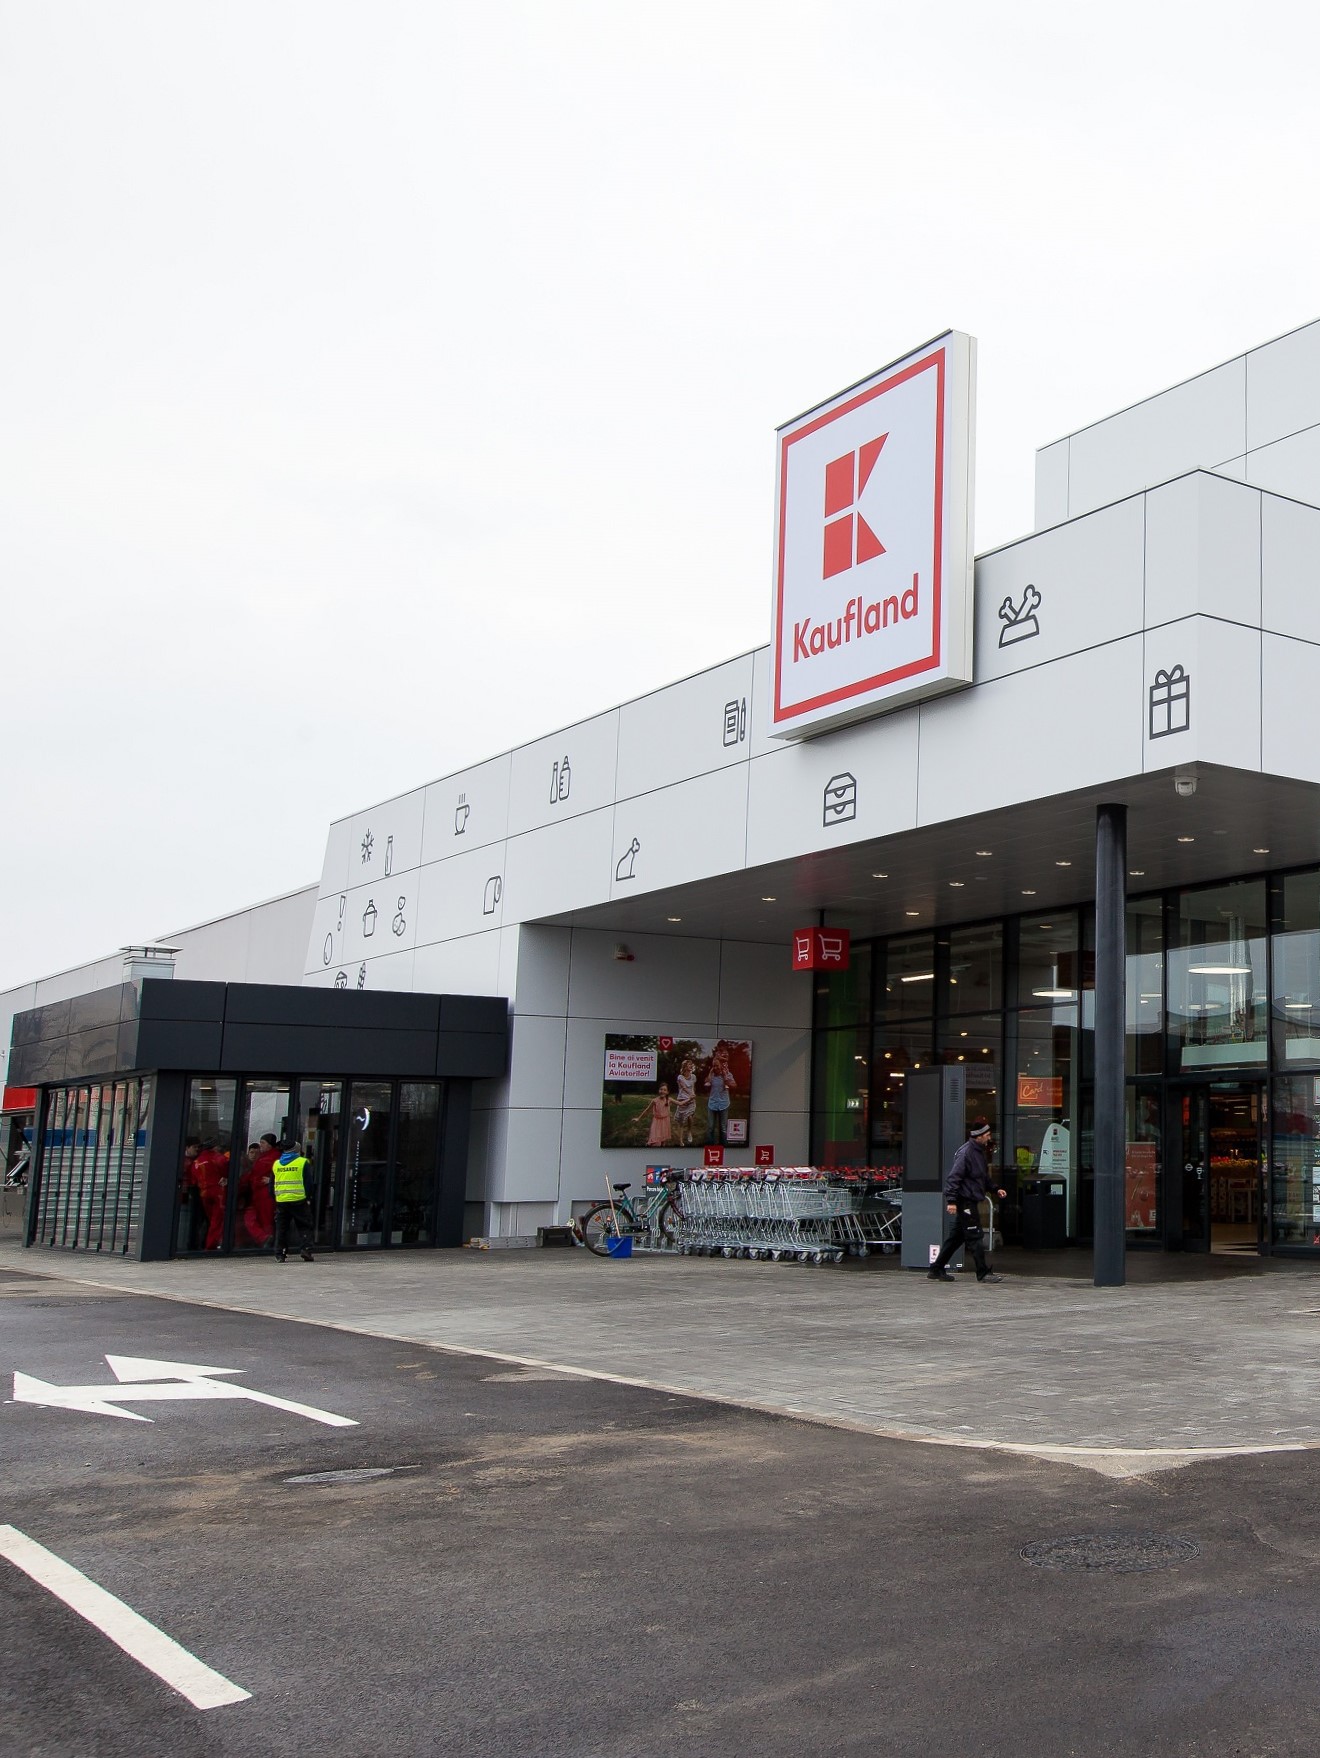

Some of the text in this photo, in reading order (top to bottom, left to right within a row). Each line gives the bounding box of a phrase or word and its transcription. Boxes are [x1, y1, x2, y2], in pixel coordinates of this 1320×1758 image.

[822, 431, 890, 581] K
[793, 572, 919, 663] Kaufland
[609, 1069, 649, 1077] Aviatorilor!
[1022, 1082, 1044, 1098] Card
